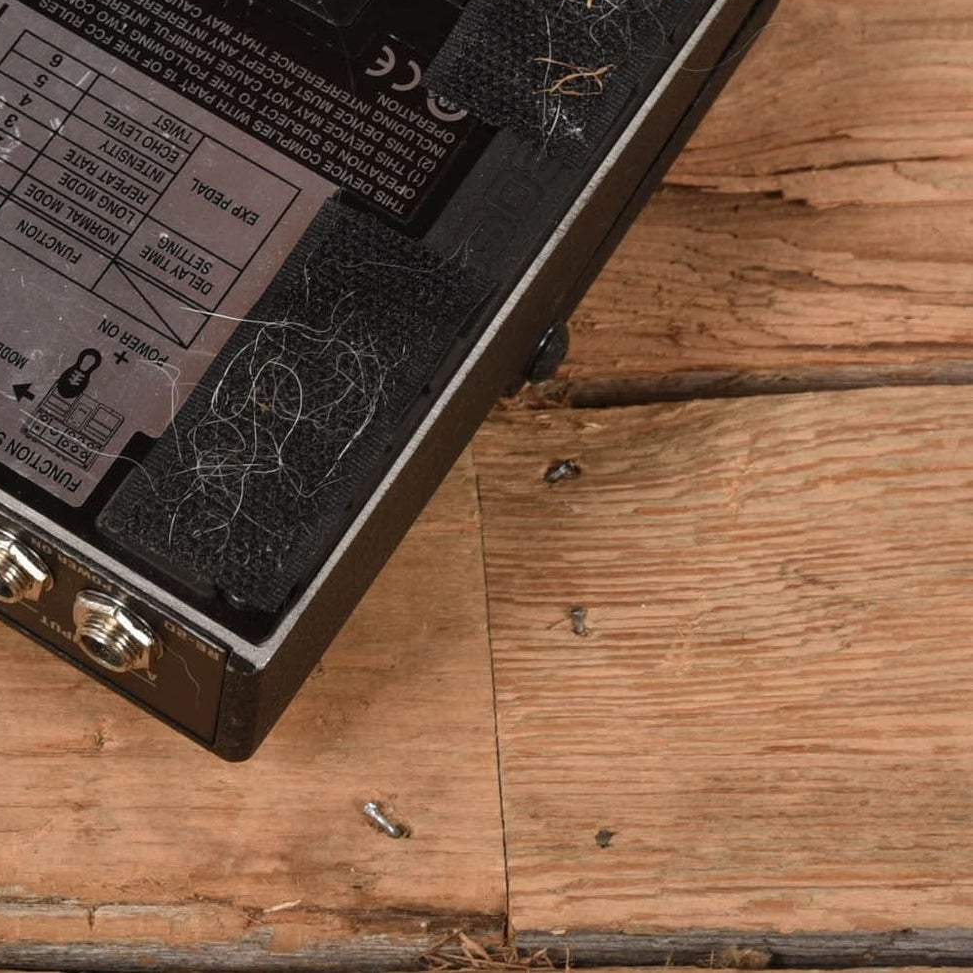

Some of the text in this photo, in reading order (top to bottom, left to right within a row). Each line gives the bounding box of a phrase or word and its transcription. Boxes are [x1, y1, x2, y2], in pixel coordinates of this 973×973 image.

[83, 21, 114, 46] FCC
[94, 9, 129, 36] TWO
[200, 13, 234, 37] MAY
[111, 37, 142, 62] THE
[127, 27, 210, 81] FOLLOWING
[152, 20, 217, 66] HARMFUL
[206, 35, 240, 58] ANY
[229, 30, 268, 58] THAT
[47, 52, 64, 69] 6
[139, 56, 163, 74] OF
[161, 66, 179, 83] 15
[213, 58, 264, 93] CAUSE
[235, 52, 296, 90] ACCEPT
[31, 72, 49, 89] 5
[176, 77, 218, 105] PART
[206, 73, 237, 98] THE
[266, 49, 372, 116] INTERFERENCE
[17, 91, 34, 108] 4
[214, 97, 252, 126] WITH
[236, 90, 258, 111] TO
[260, 86, 294, 111] NOT
[291, 84, 335, 114] MUST
[2, 112, 19, 129] 3
[150, 113, 194, 146] TWIST
[256, 103, 323, 146] SUBJECT
[291, 104, 326, 128] MAY
[331, 105, 386, 143] DEVICE
[375, 90, 456, 145] OPERATION.
[101, 109, 181, 165] ECHO LEVEL
[250, 118, 322, 166] COMPLIES
[320, 119, 376, 157] DEVICE
[320, 139, 339, 156] IS
[370, 108, 447, 159] INCLUDING
[383, 135, 416, 162] THIS
[61, 147, 151, 206] REPEAT RATE
[96, 138, 167, 185] INTENSITY
[319, 158, 374, 196] DEVICE
[335, 147, 417, 200] OPERATION
[373, 149, 406, 177] THIS
[415, 154, 437, 174] (2)
[405, 167, 427, 188] (1)
[56, 170, 137, 225] LONG MODE
[189, 176, 261, 227] EXP PEDAL
[372, 188, 405, 216] THIS
[22, 181, 121, 247] NORMAL MODE
[13, 217, 83, 265] FUNCTION
[155, 235, 214, 276] SETTING
[137, 243, 214, 297] DELAY TIME
[95, 317, 170, 368] POWER ON
[2, 437, 83, 494] FUNCTION
